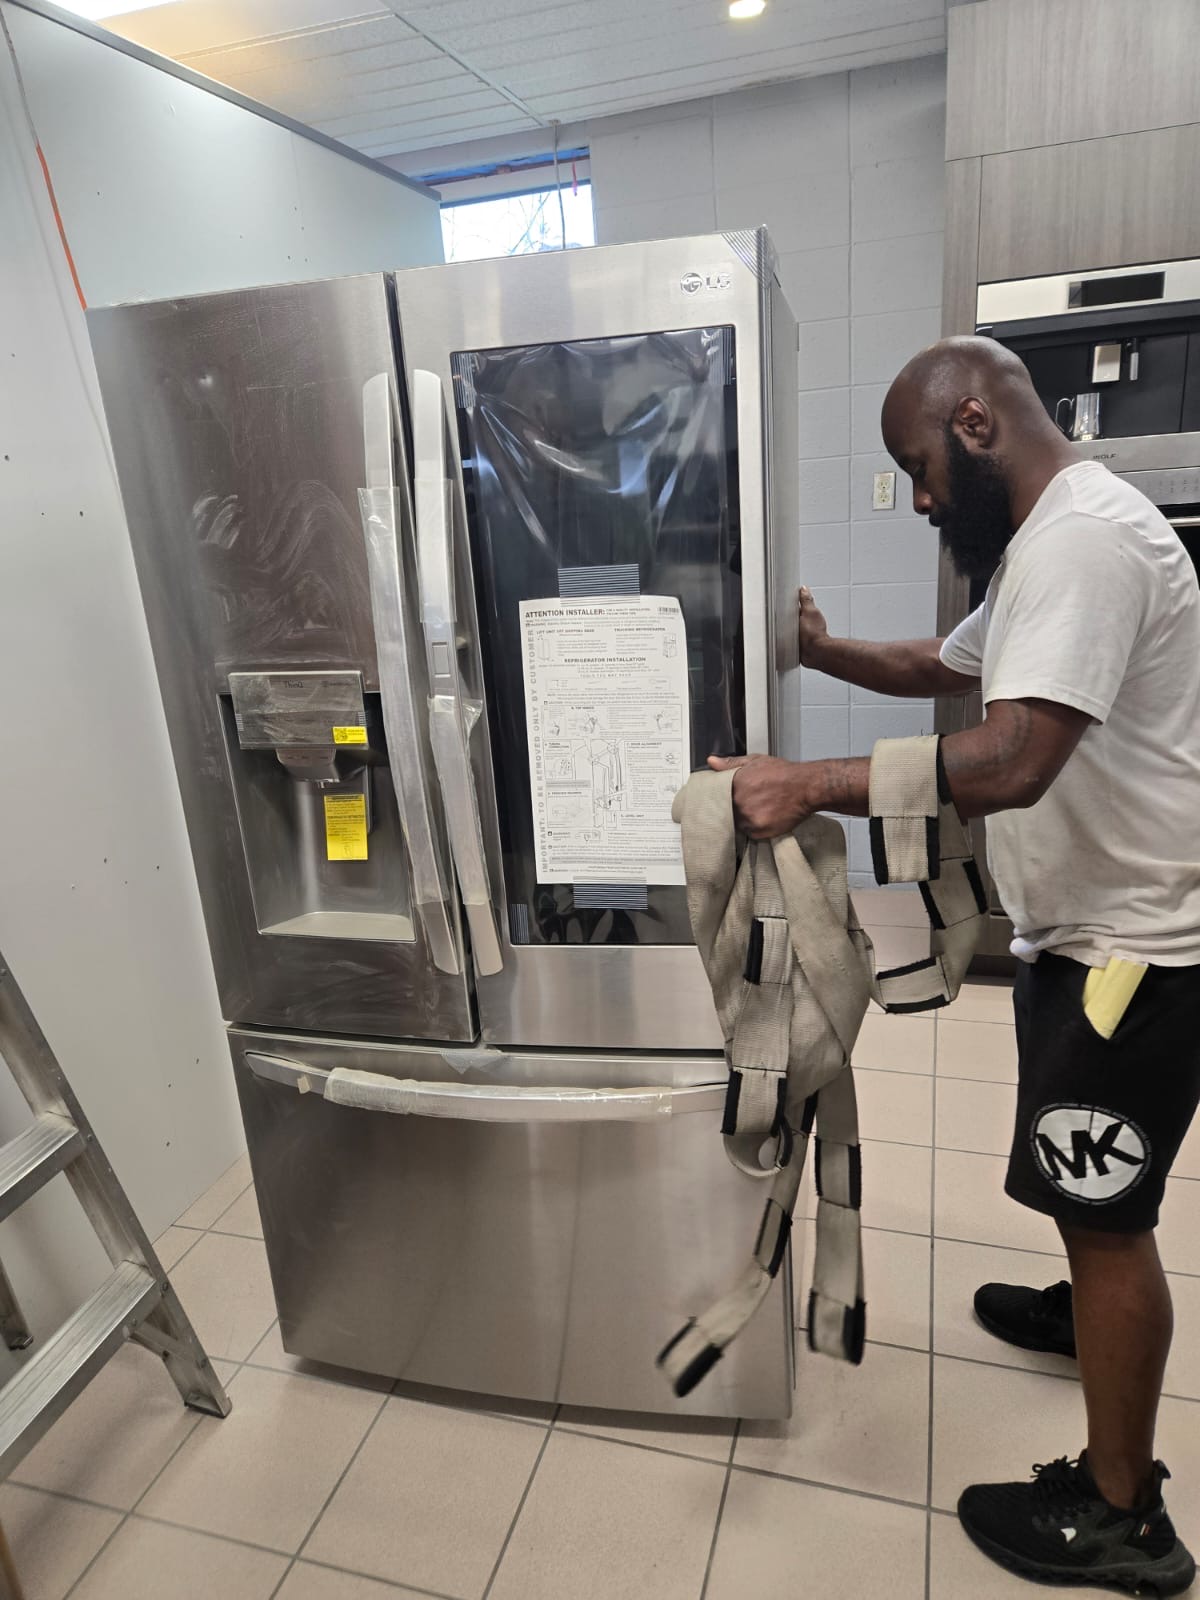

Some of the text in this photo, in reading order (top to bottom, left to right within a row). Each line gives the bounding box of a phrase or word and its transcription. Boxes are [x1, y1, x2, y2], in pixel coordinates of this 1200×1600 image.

[706, 274, 730, 289] LG
[525, 608, 606, 618] ATTENTION INSTALLER:
[527, 630, 537, 684] CUSTOMER
[532, 706, 540, 731] ONLY
[534, 736, 543, 781] REMOVED
[1036, 1120, 1146, 1181] MK
